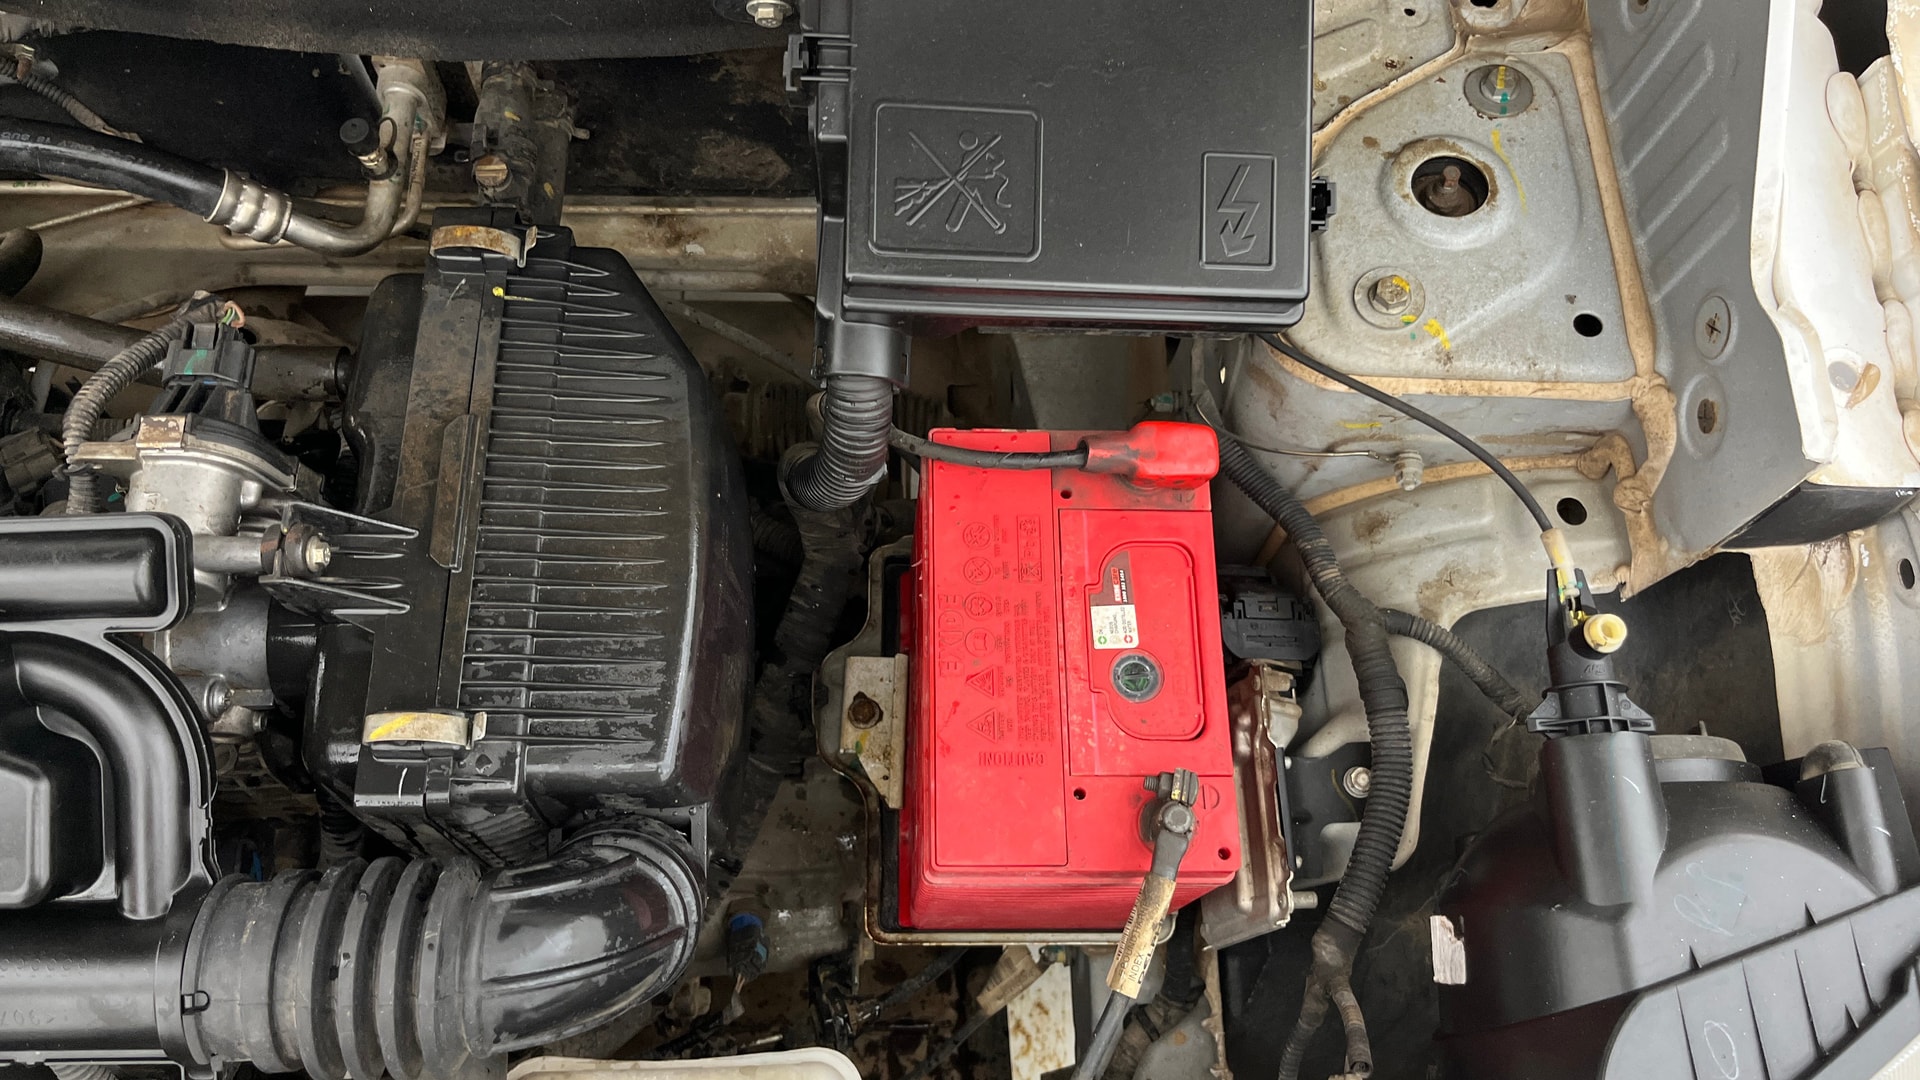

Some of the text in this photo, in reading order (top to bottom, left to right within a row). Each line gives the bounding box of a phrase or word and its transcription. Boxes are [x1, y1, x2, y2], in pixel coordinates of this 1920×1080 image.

[938, 593, 965, 678] EXIDE
[978, 751, 1048, 768] CAUTION!
[1127, 952, 1145, 982] INDEX
